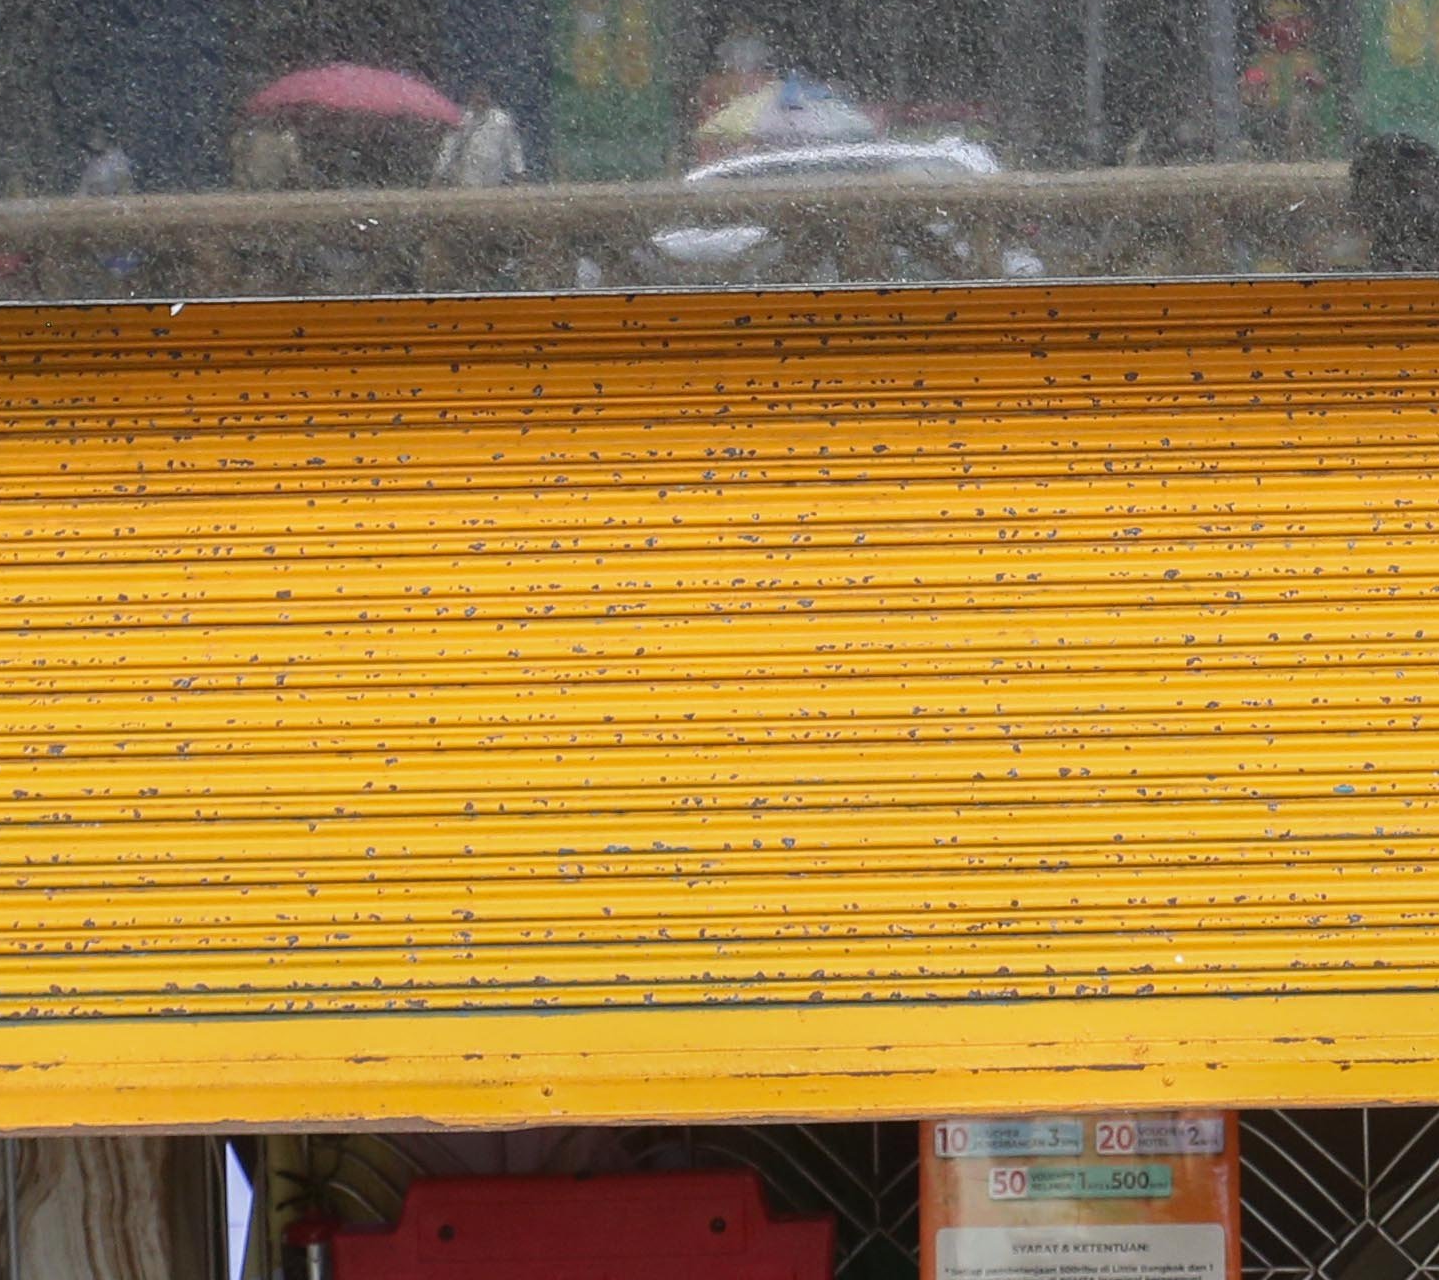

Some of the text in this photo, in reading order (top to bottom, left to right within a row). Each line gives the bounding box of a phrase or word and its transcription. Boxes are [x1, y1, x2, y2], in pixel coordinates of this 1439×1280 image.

[937, 1126, 968, 1153] 10
[1099, 1125, 1134, 1151] 20
[993, 1170, 1027, 1195] 50
[1112, 1171, 1150, 1190] 500
